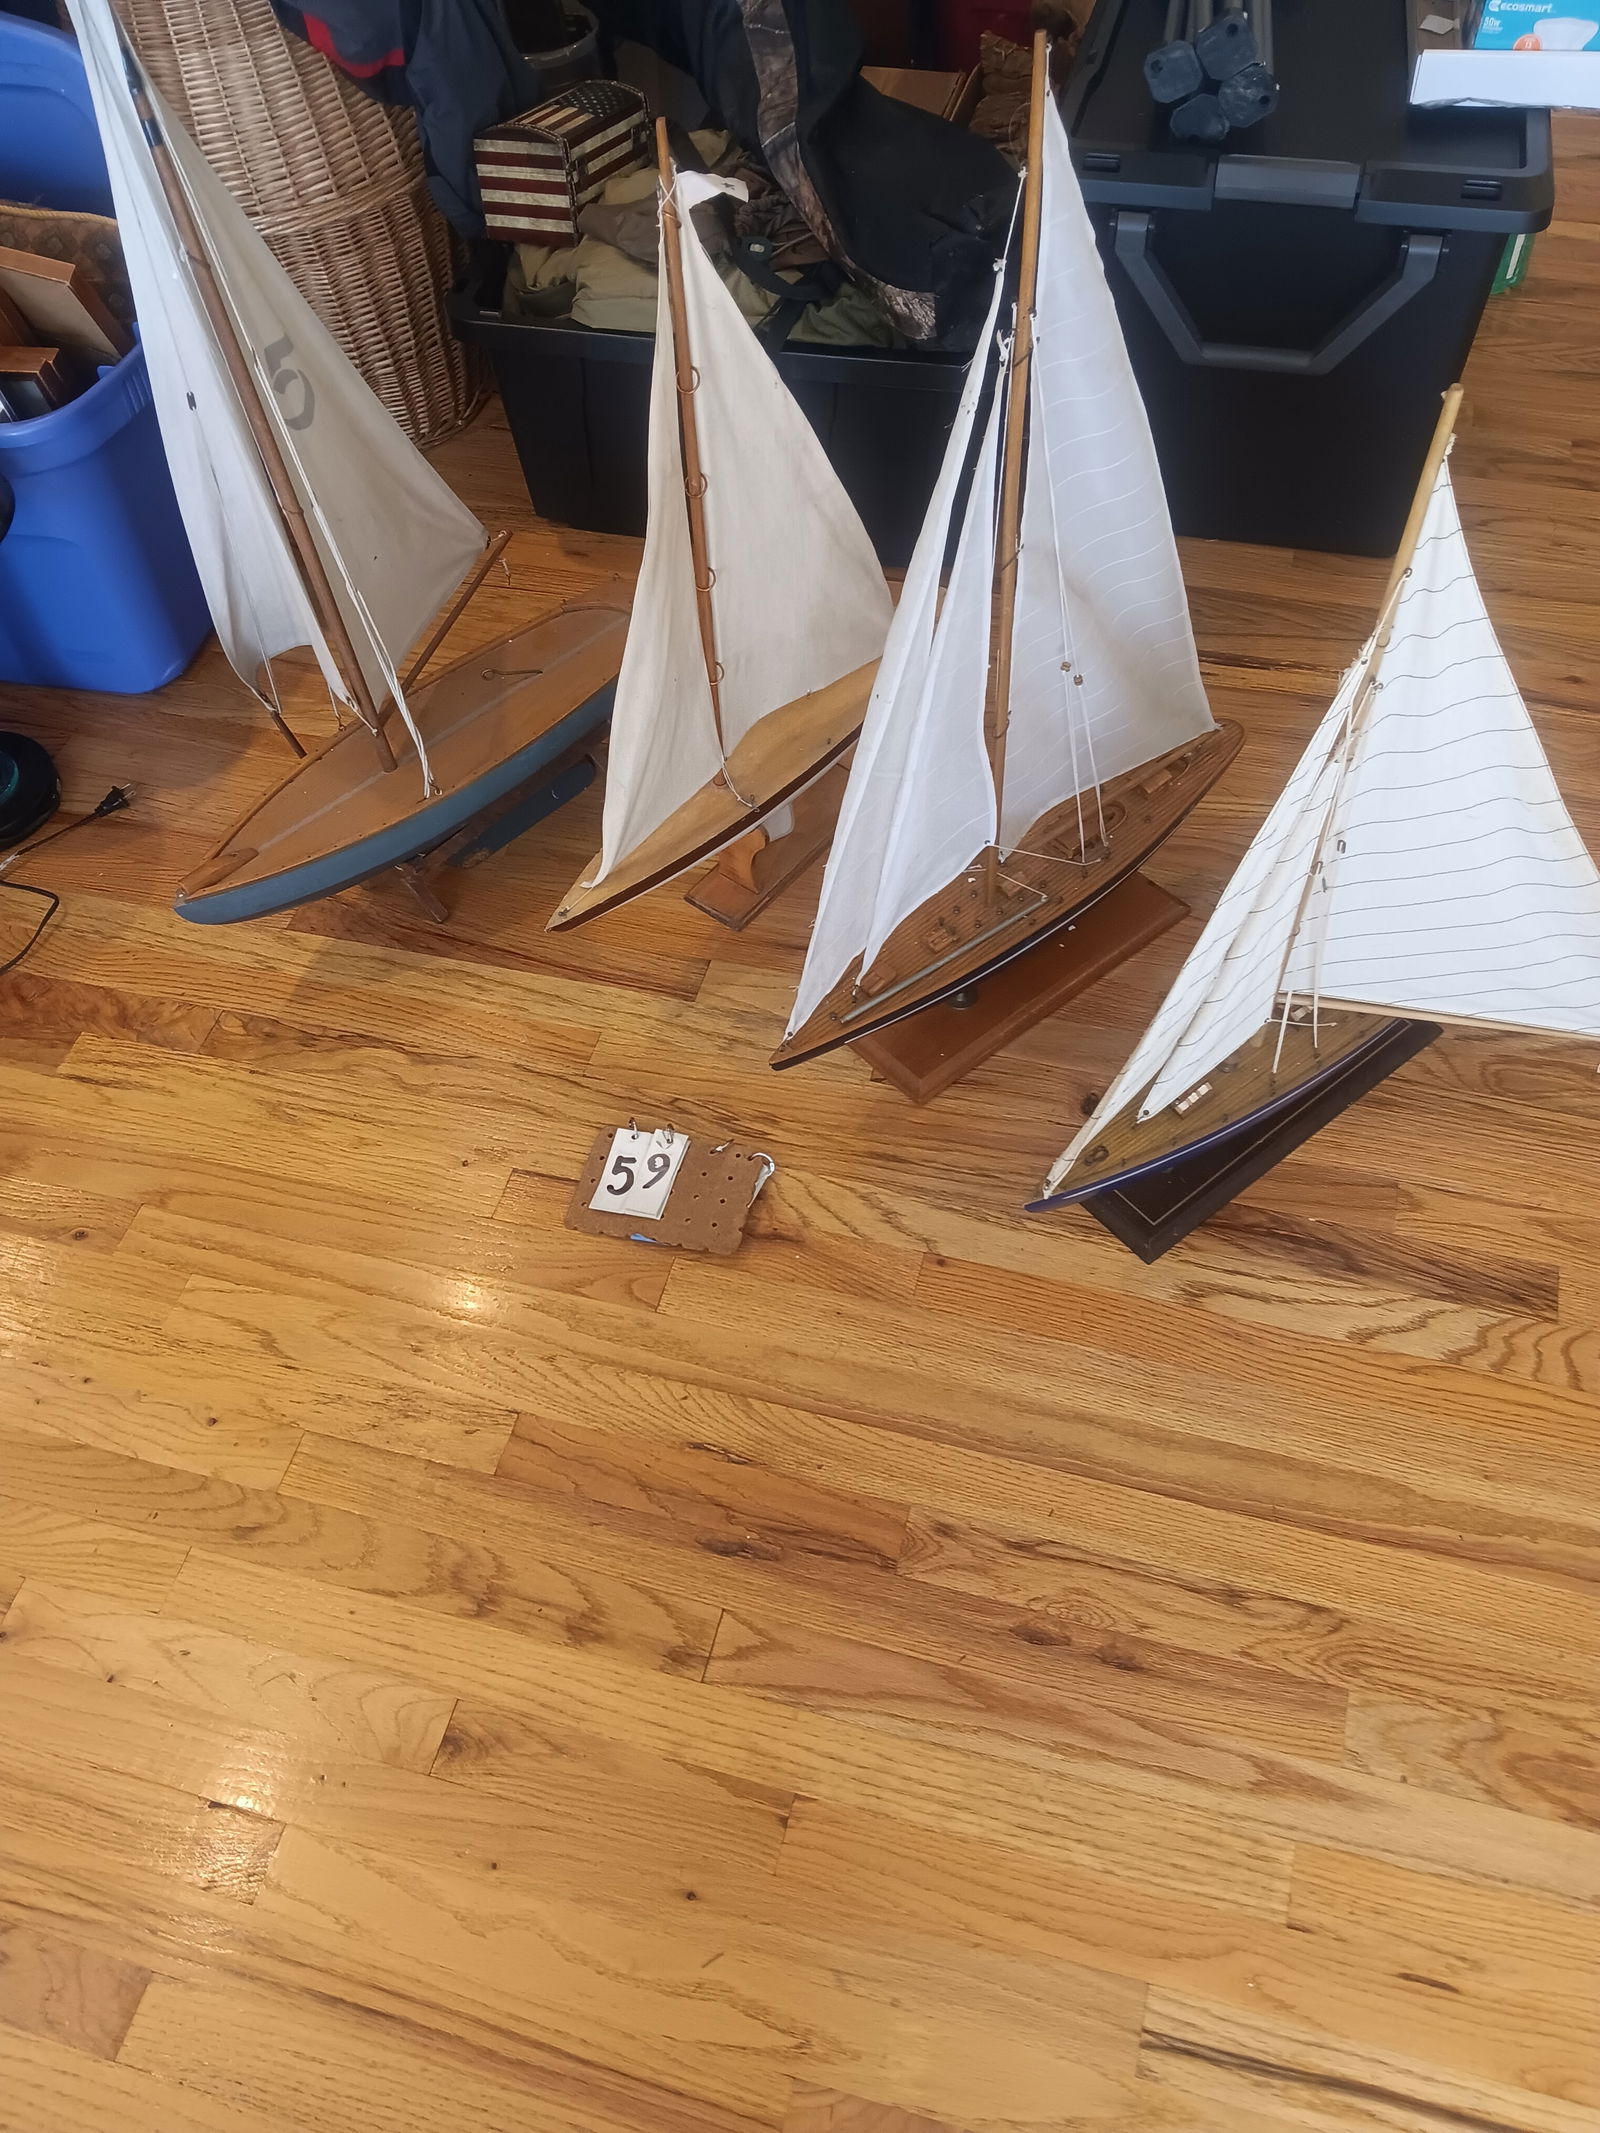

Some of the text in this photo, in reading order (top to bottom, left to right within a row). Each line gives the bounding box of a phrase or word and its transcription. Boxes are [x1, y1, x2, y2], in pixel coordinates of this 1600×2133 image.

[1500, 2, 1553, 13] ecosmart
[264, 334, 316, 431] 5
[606, 1153, 671, 1196] 59
